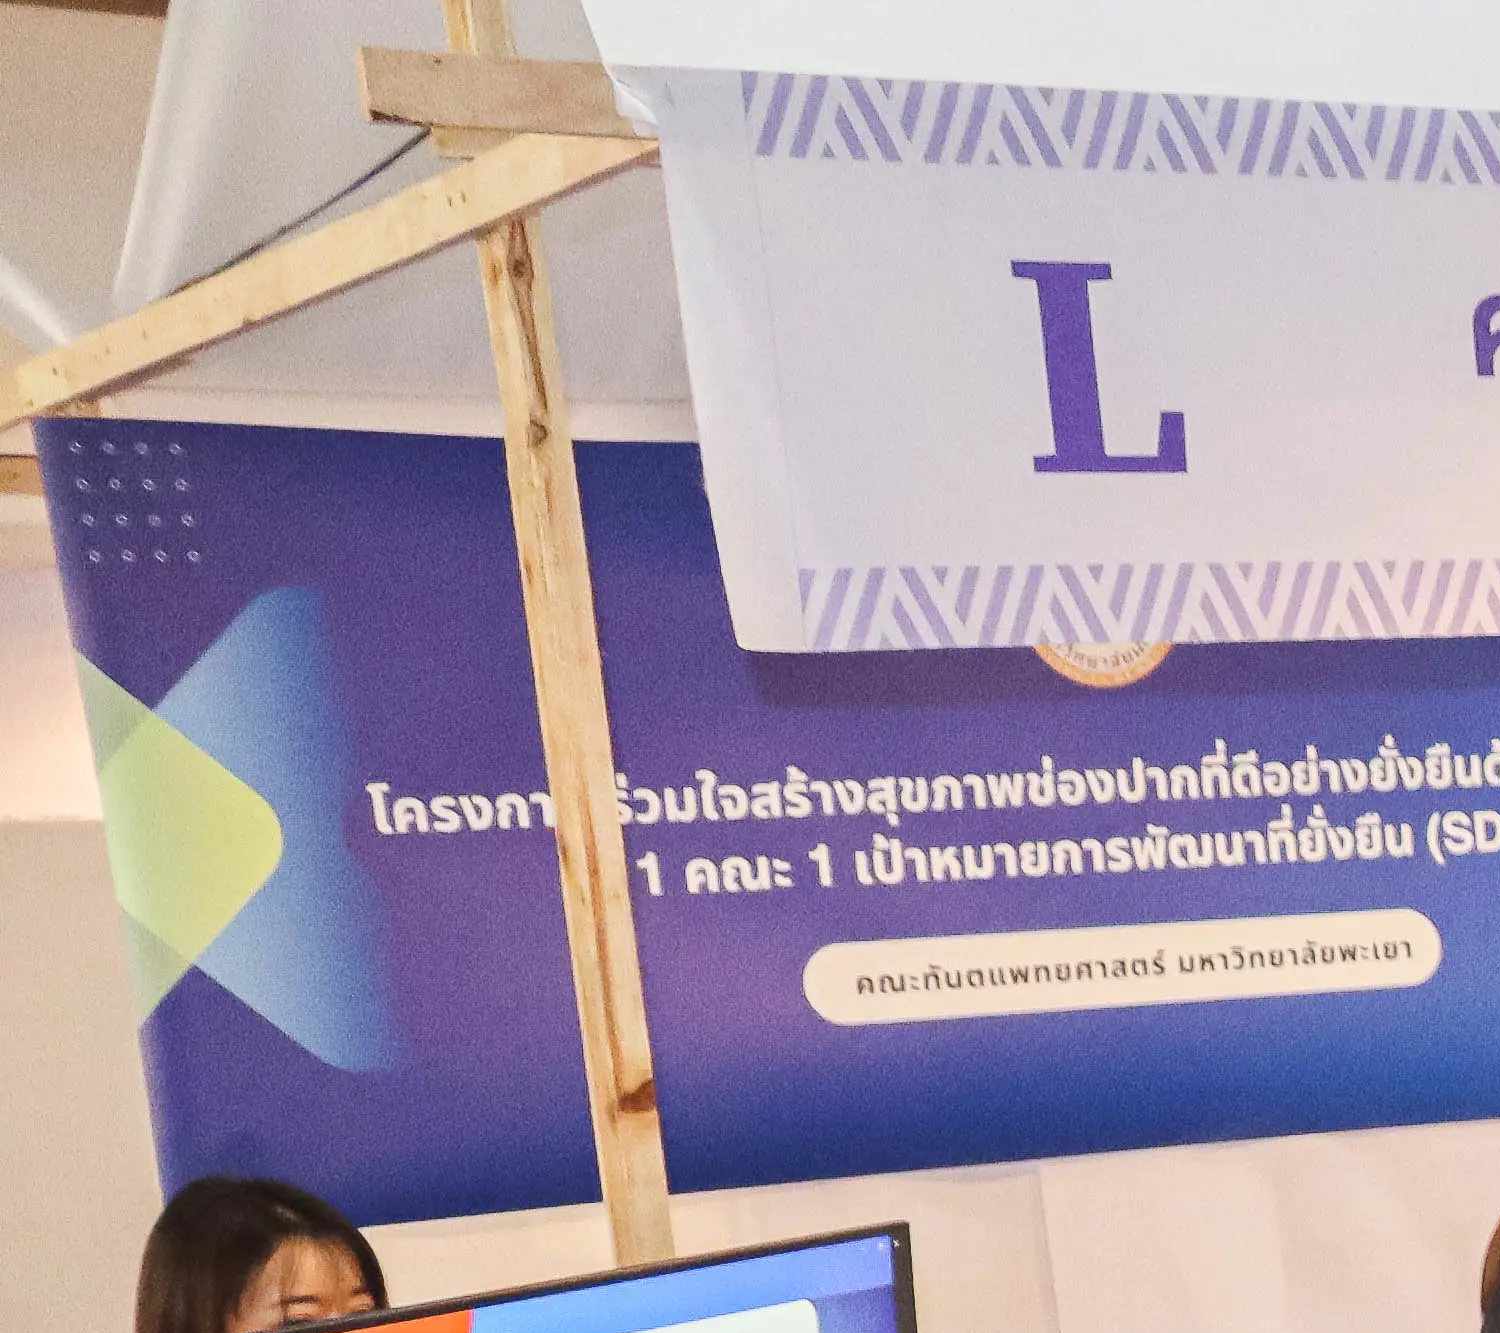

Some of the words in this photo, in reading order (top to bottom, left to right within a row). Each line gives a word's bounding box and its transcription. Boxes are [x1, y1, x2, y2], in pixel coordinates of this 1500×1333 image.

[1010, 259, 1188, 474] L
[637, 857, 664, 896] 1
[685, 858, 793, 895] คณะ
[809, 843, 834, 889] 1
[854, 804, 1413, 886] เป้าหมายการพัฒนาที่ยั่งยืน
[855, 947, 1169, 997] คณะทันตแพทยศาสตร์
[1179, 931, 1413, 978] มหาวิทยาลัยพะเยา
